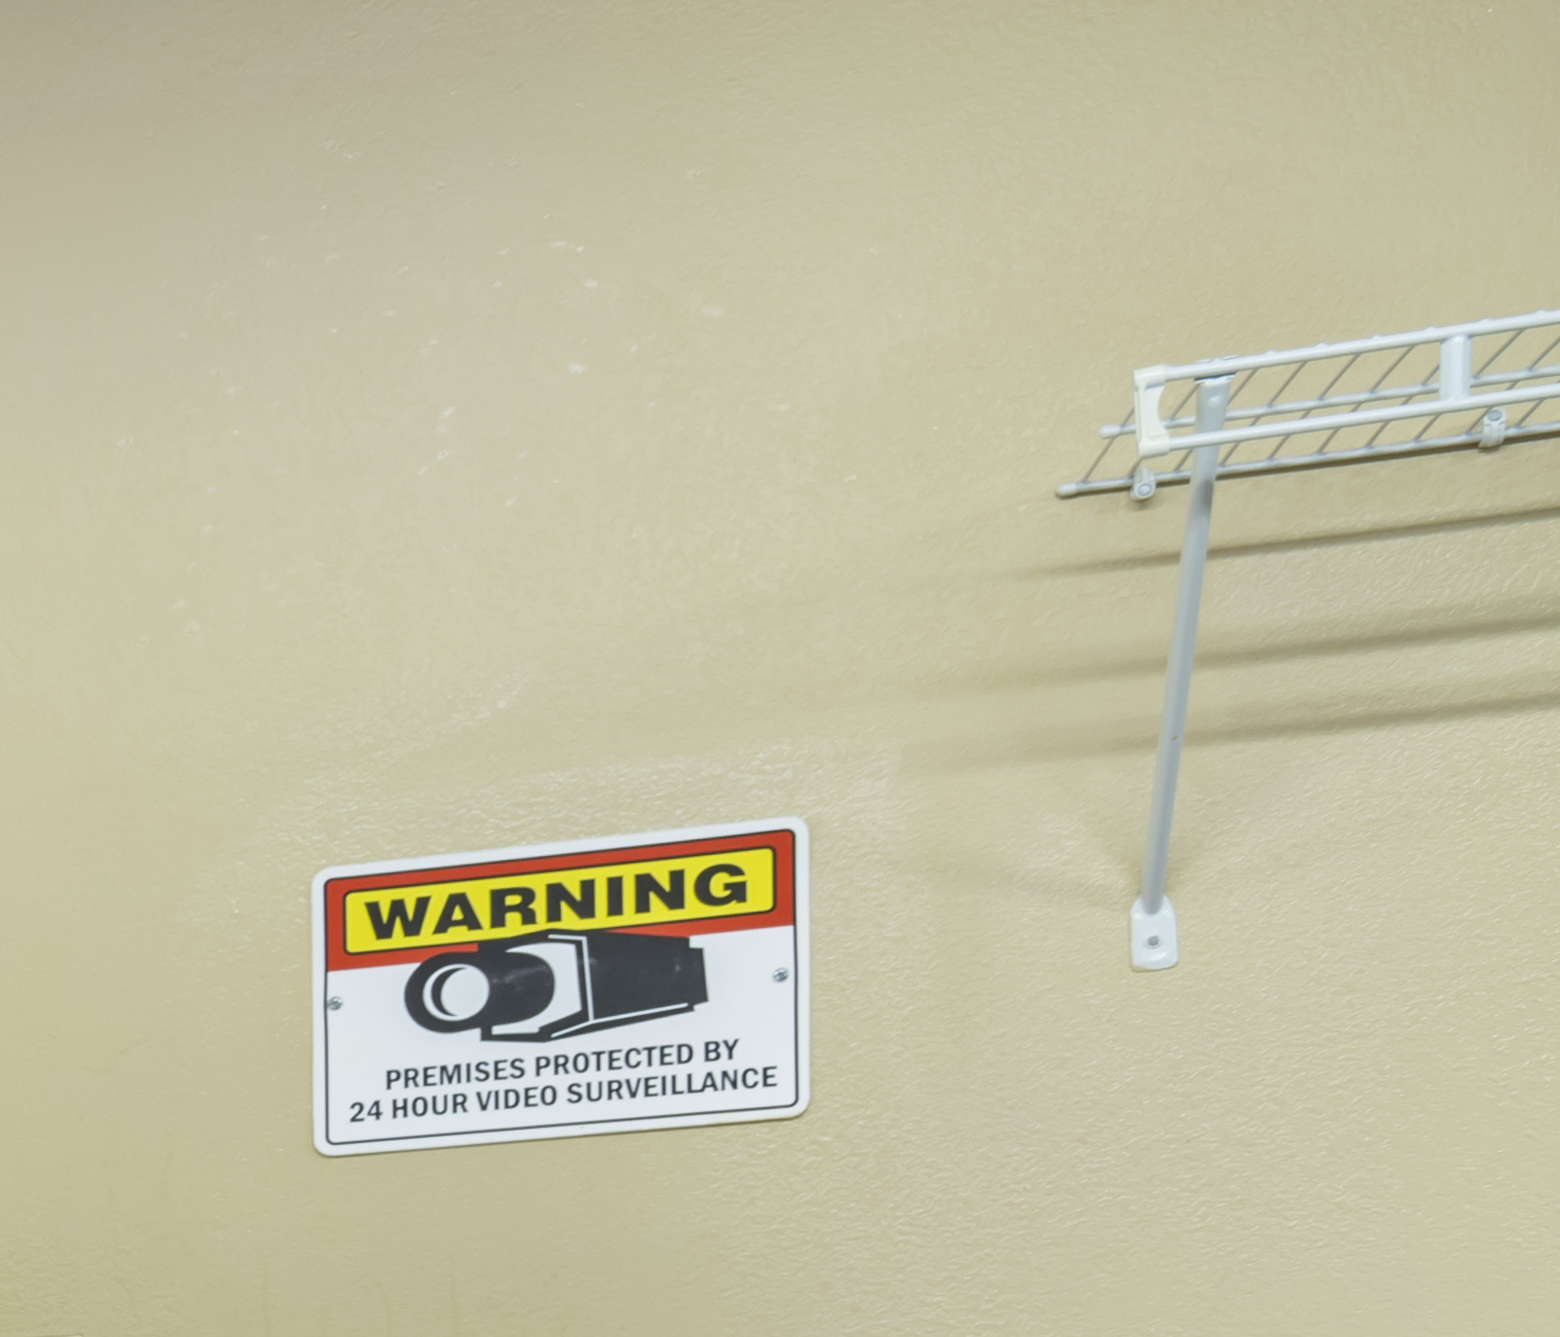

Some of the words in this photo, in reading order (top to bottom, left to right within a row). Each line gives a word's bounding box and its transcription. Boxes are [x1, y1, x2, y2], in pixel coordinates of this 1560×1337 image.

[365, 863, 749, 941] WARNING
[385, 1057, 525, 1091] PREMISES
[534, 1041, 694, 1078] PROTECTED
[703, 1038, 740, 1063] BY
[349, 1099, 383, 1123] 24
[391, 1090, 468, 1120] HOUR
[476, 1083, 558, 1112] VIDEO
[565, 1065, 779, 1105] SURVEILLANCE
